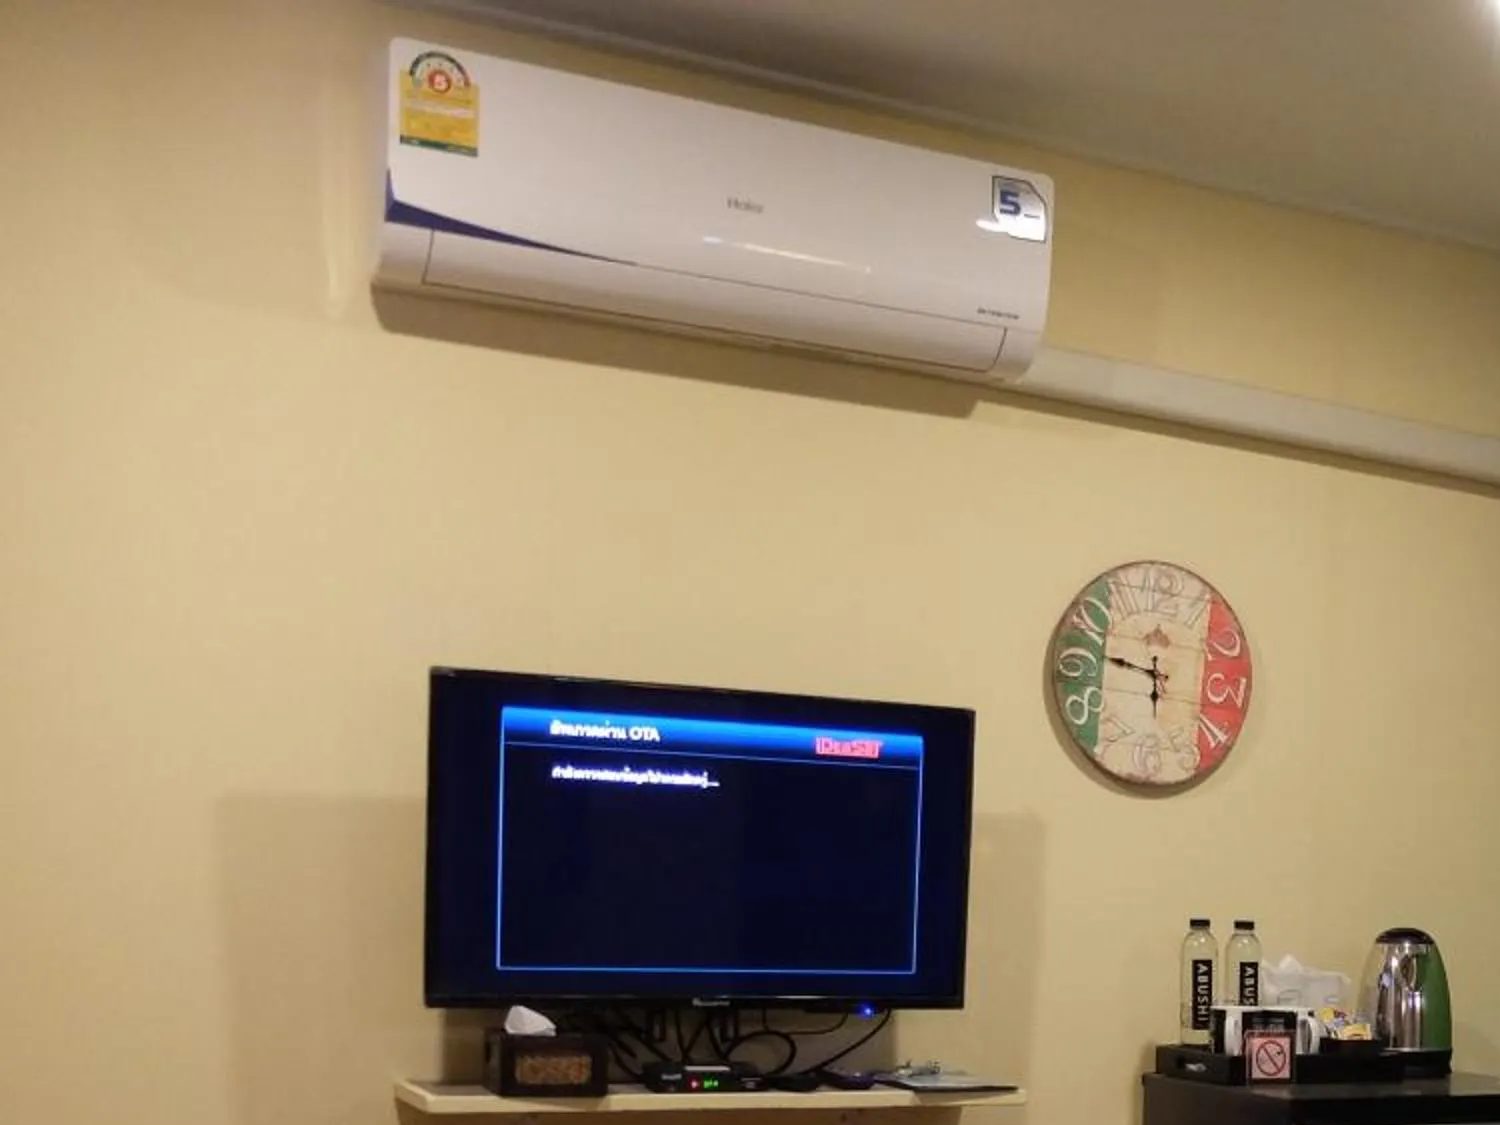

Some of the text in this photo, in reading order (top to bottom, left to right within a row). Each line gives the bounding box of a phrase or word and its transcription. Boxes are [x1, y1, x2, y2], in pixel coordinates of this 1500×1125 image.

[999, 189, 1021, 216] 5
[1206, 626, 1242, 662] 2
[1058, 647, 1099, 680] 9
[1065, 686, 1105, 726] 8
[1206, 672, 1248, 708] 3
[629, 726, 660, 742] OTA
[1197, 963, 1208, 1021] ABUSHI
